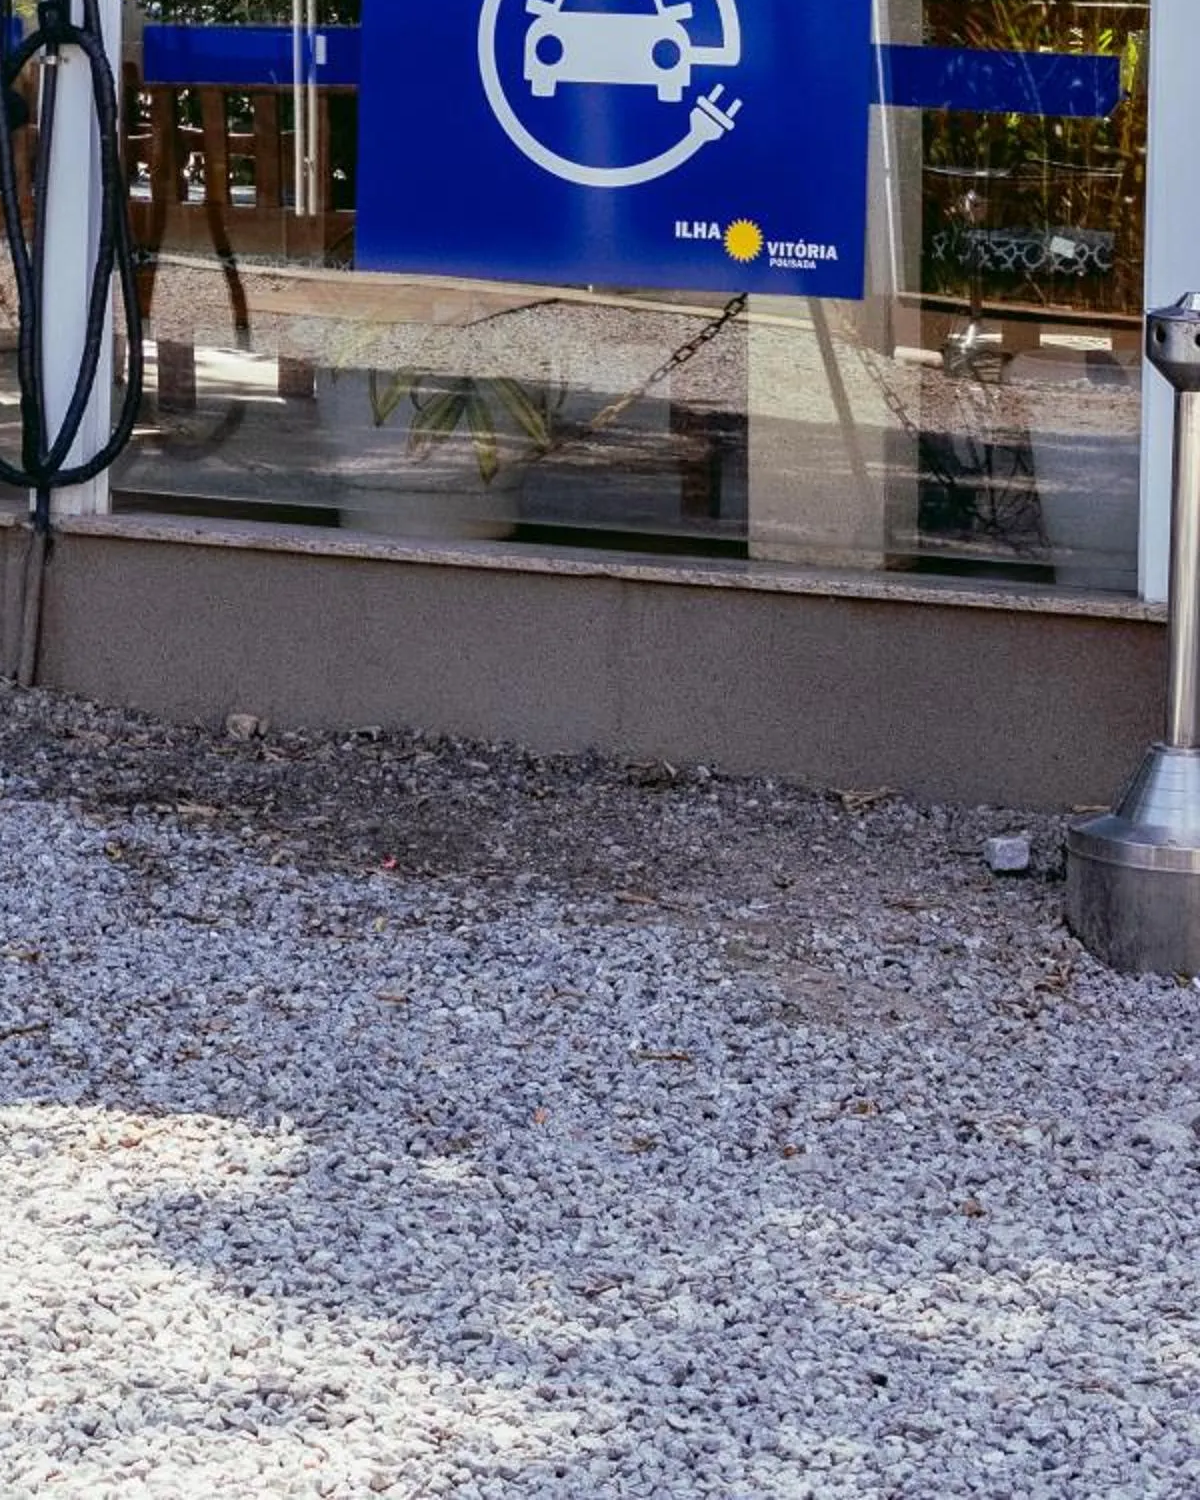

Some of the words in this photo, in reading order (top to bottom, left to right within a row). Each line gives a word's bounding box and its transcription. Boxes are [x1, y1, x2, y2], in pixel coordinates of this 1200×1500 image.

[675, 220, 721, 240] ILHA
[767, 238, 839, 261] VITÓRIA
[769, 258, 816, 269] POUSADA
